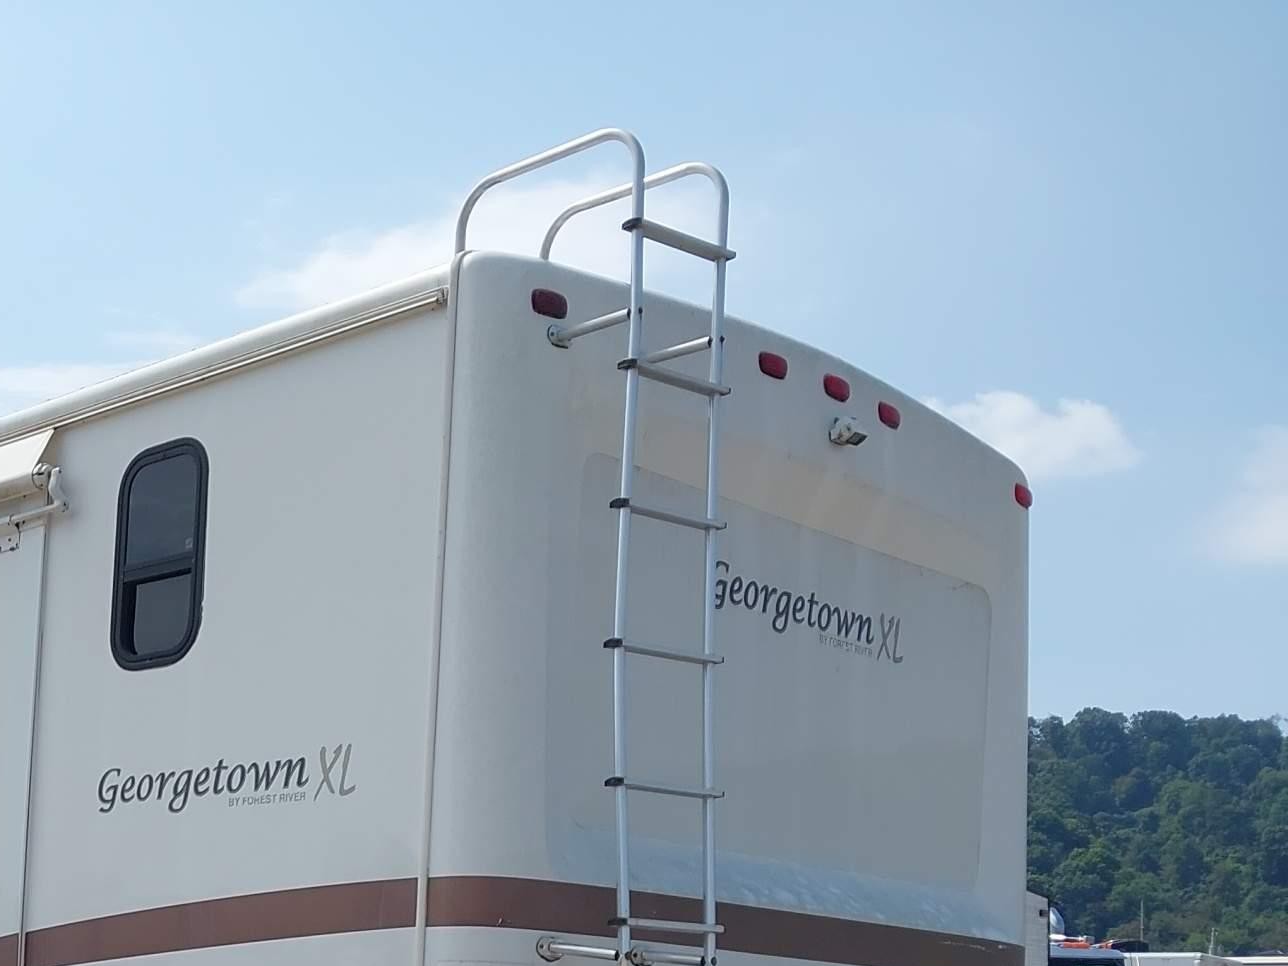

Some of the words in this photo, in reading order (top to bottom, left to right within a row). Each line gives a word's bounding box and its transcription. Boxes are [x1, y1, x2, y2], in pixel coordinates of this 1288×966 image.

[876, 612, 904, 664] XL
[98, 757, 310, 813] Georgetown
[313, 743, 357, 802] XL
[228, 797, 240, 808] BY
[242, 793, 277, 806] FOREST
[278, 791, 306, 803] RIVER
